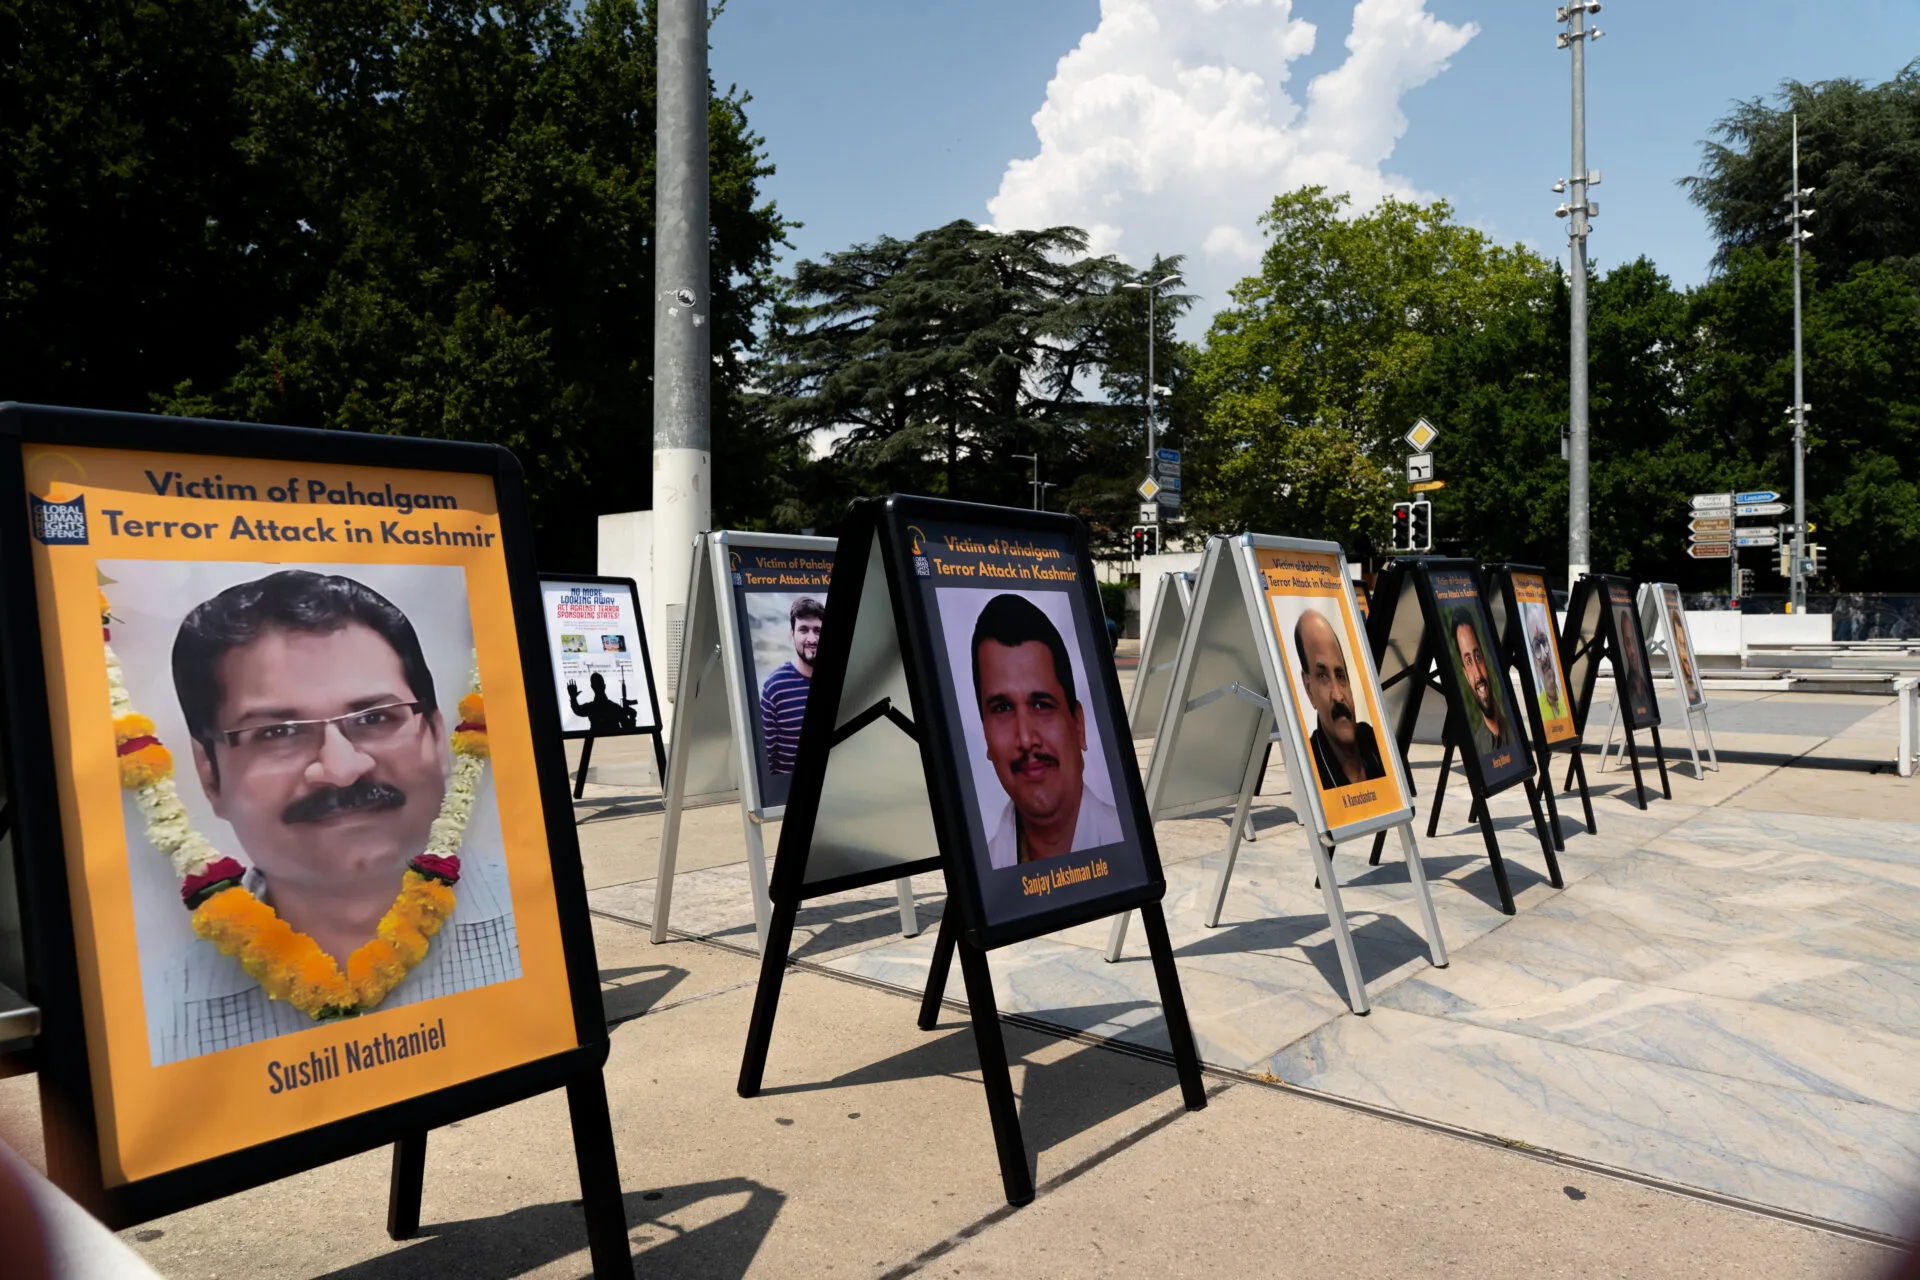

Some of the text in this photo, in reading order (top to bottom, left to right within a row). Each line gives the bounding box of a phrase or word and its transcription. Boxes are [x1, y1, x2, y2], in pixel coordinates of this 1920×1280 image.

[145, 470, 458, 514] Victim of Pahalgam
[101, 509, 496, 548] Terror Attack in Kashmir
[944, 536, 1060, 561] Victim of Pahalgam
[755, 556, 834, 573] Victim of Pahalg
[933, 558, 1076, 582] Terror Attack in Kashmir
[1272, 558, 1295, 570] Victim
[745, 573, 777, 585] Terror
[779, 573, 810, 585] Attack
[811, 573, 821, 585] in
[1268, 575, 1290, 587] Terror
[1292, 577, 1311, 589] Attack
[1312, 578, 1319, 588] in
[561, 595, 615, 605] LOOKING AWAY
[571, 588, 603, 597] NO MORE
[1022, 858, 1109, 896] Sanjay Lakshman Lele
[268, 1018, 446, 1094] Sushil Nathaniel
